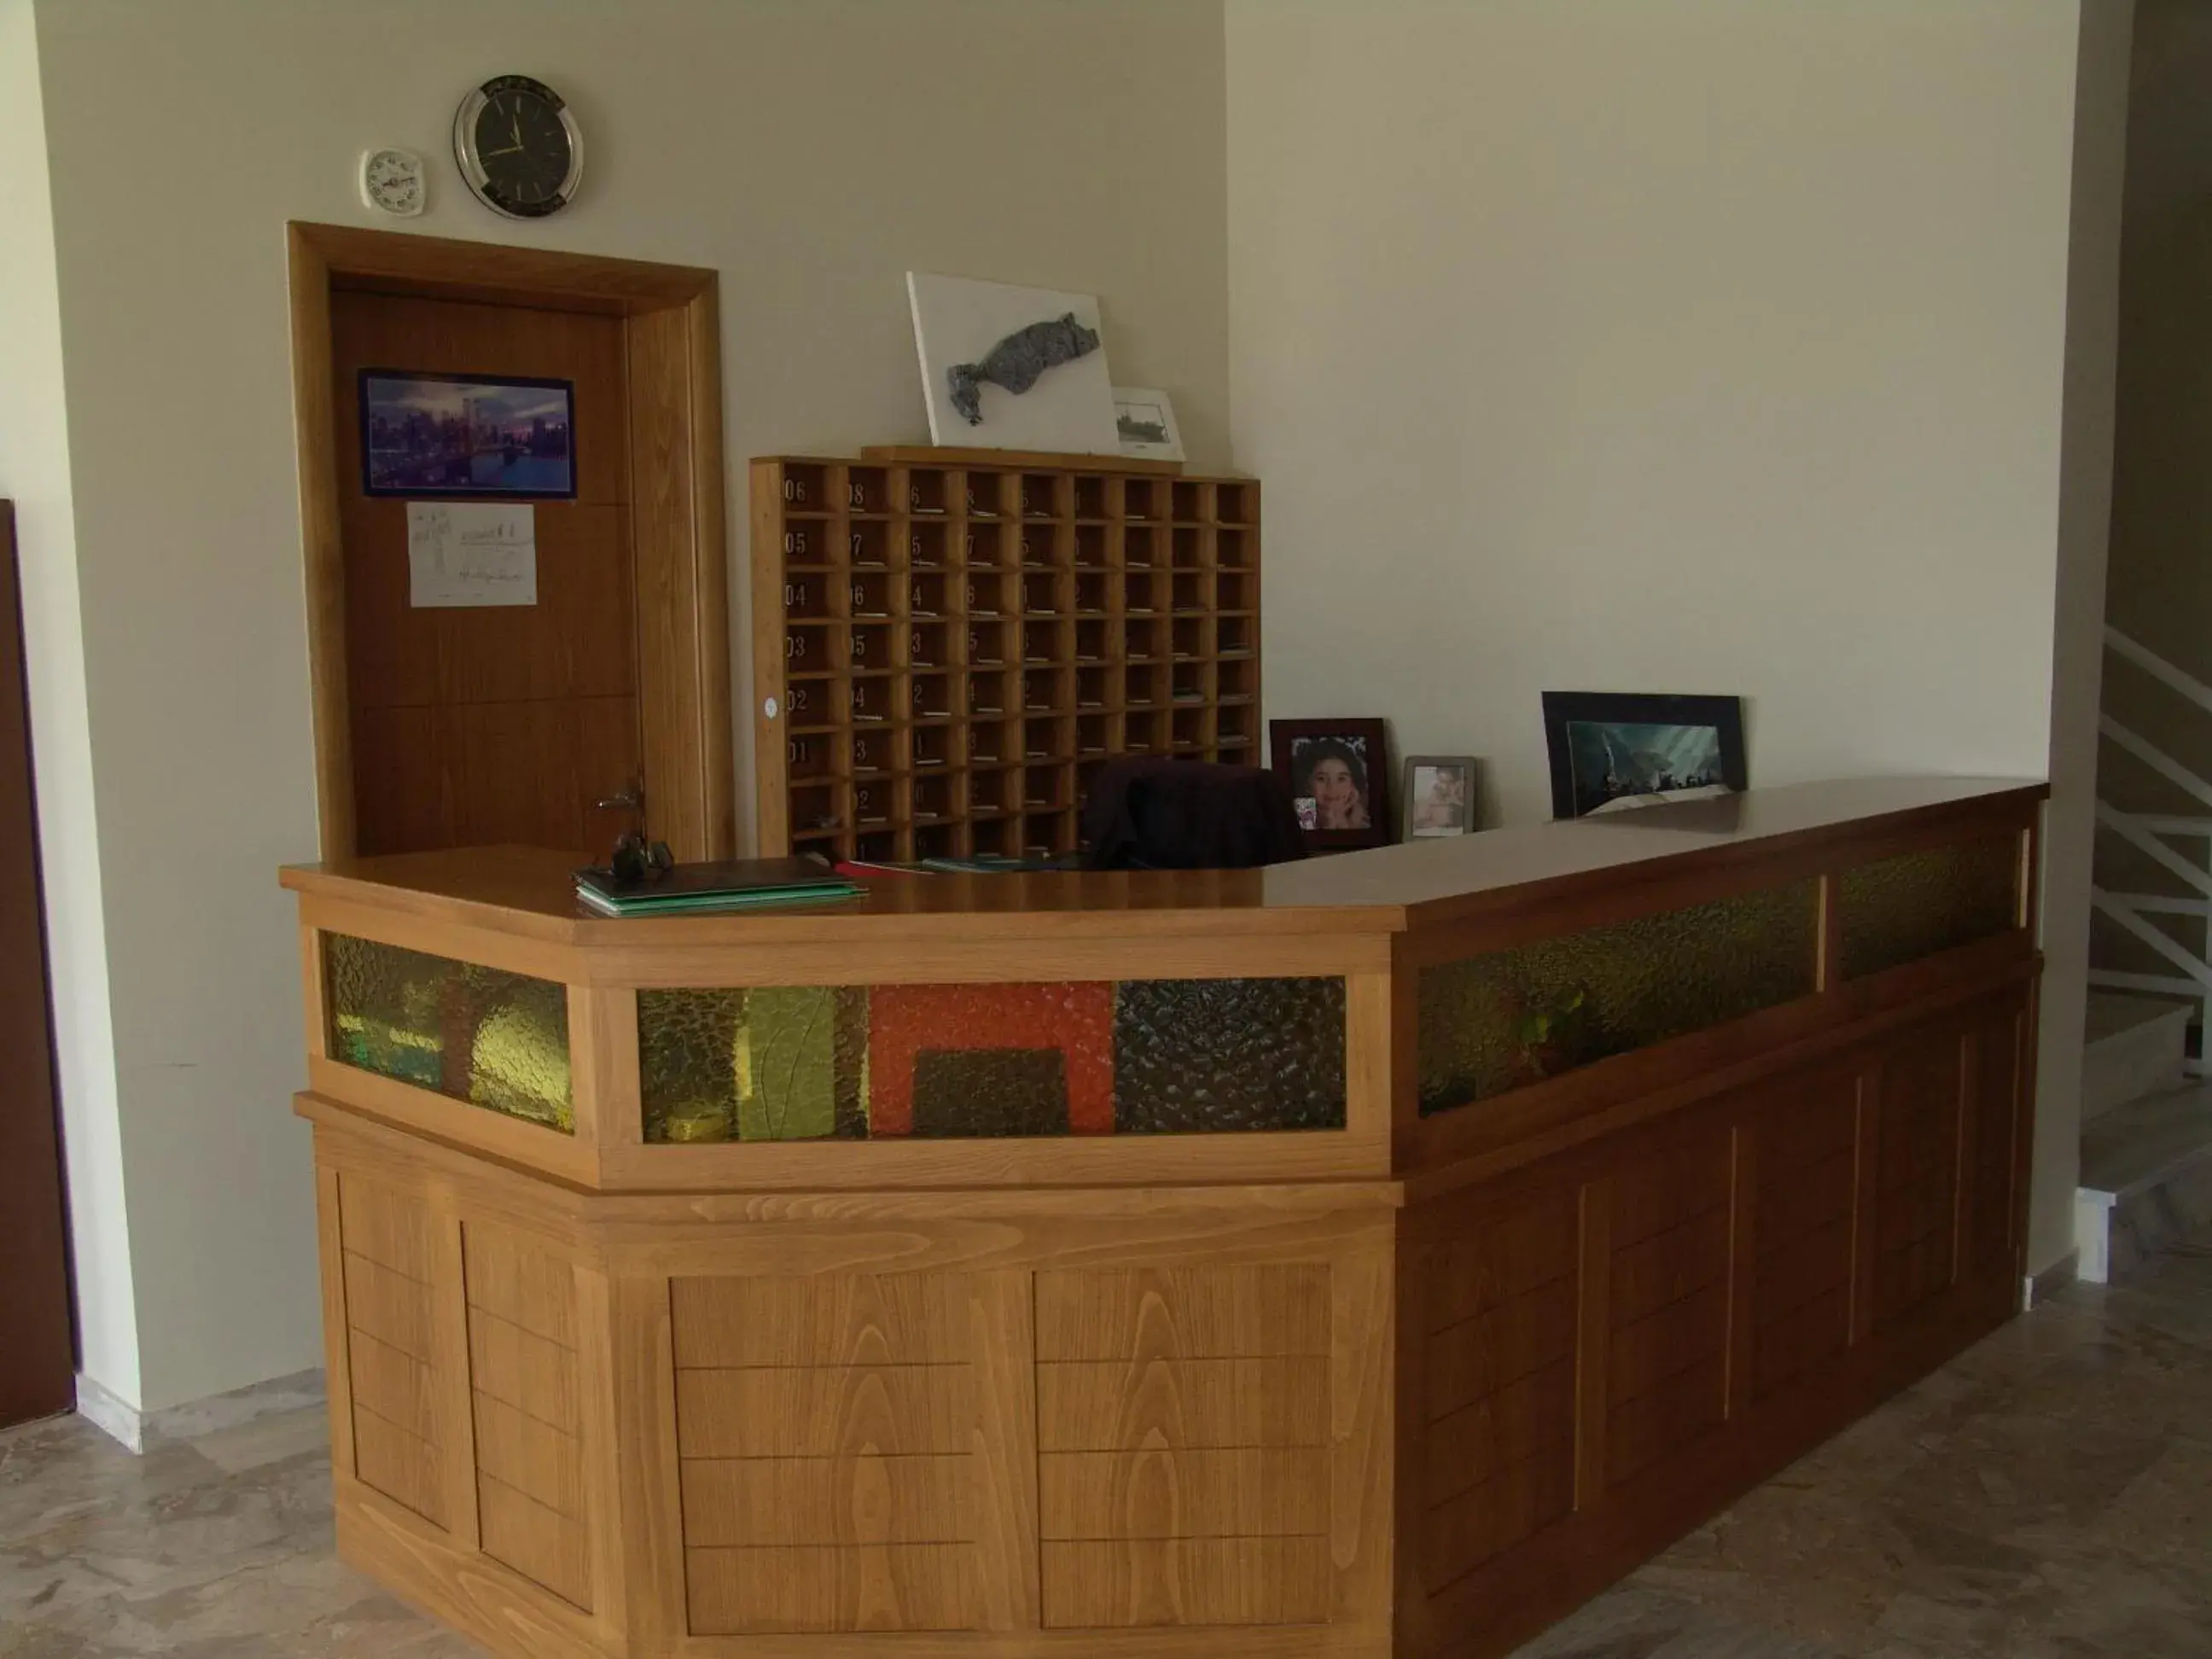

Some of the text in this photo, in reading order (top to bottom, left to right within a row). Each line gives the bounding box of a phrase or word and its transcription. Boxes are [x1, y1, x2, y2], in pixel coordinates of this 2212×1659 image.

[784, 479, 806, 502] 06
[784, 532, 806, 554] 05
[784, 584, 806, 607] 04
